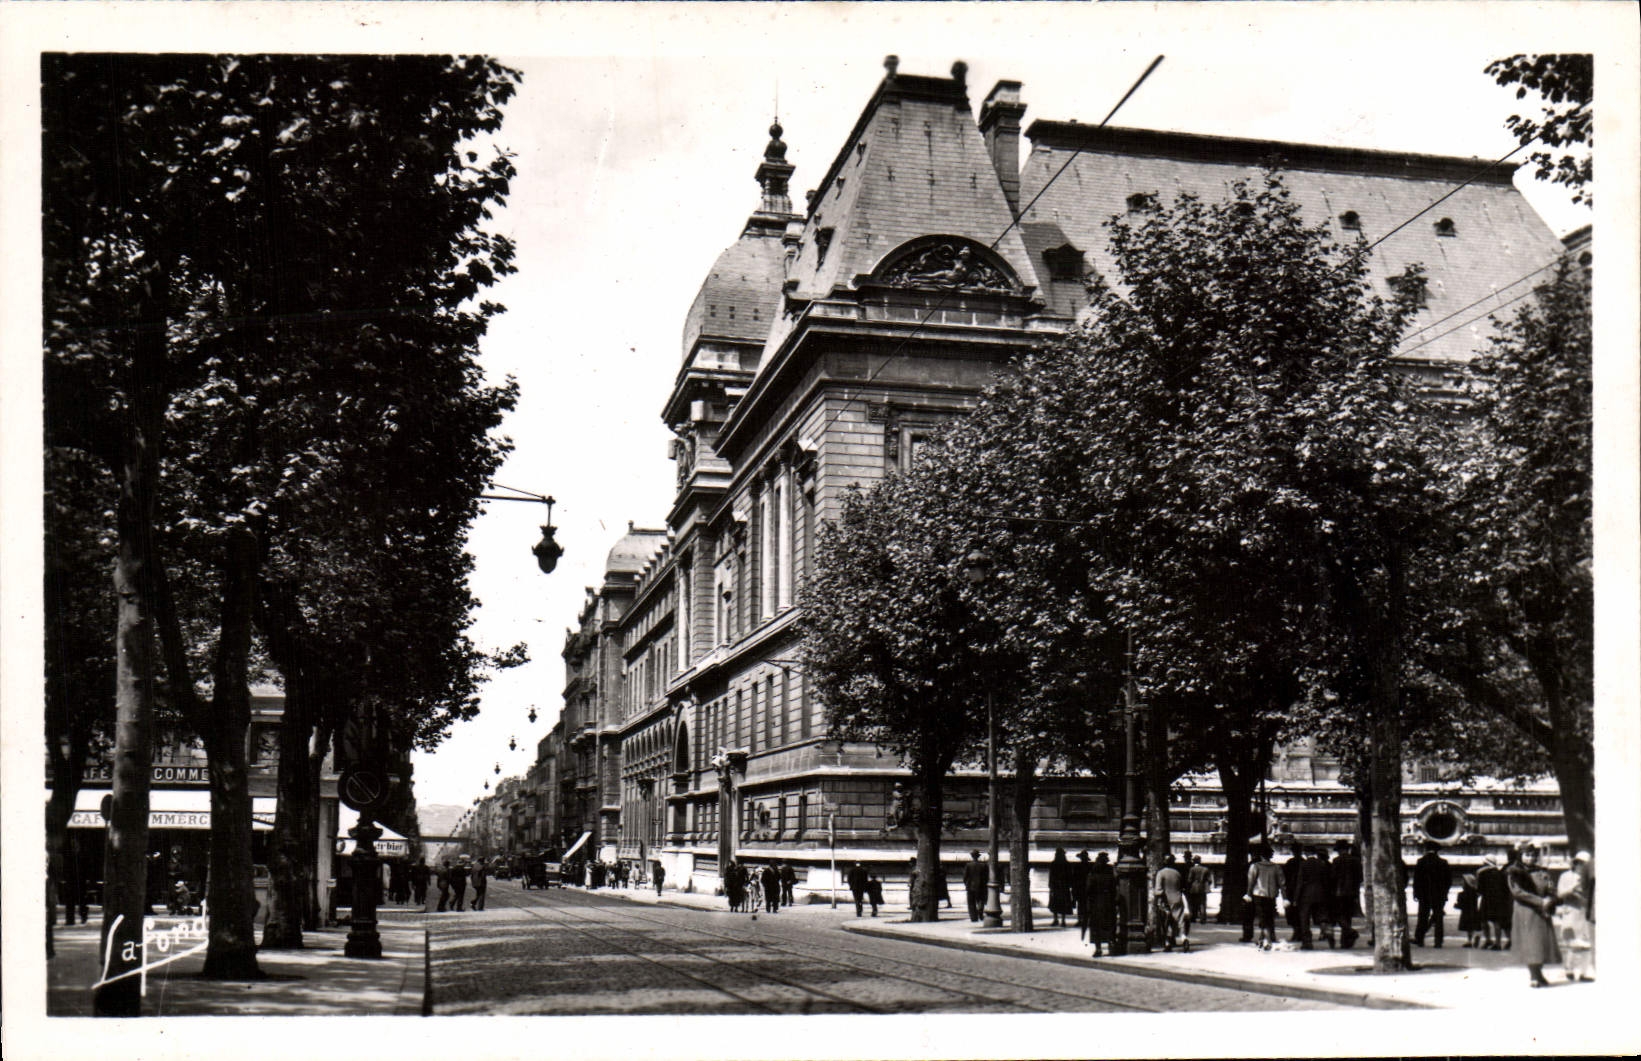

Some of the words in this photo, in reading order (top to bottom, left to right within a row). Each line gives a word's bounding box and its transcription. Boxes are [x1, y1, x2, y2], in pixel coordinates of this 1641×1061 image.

[154, 767, 210, 781] COMME
[71, 813, 102, 825] CAF
[151, 813, 208, 825] MMERC
